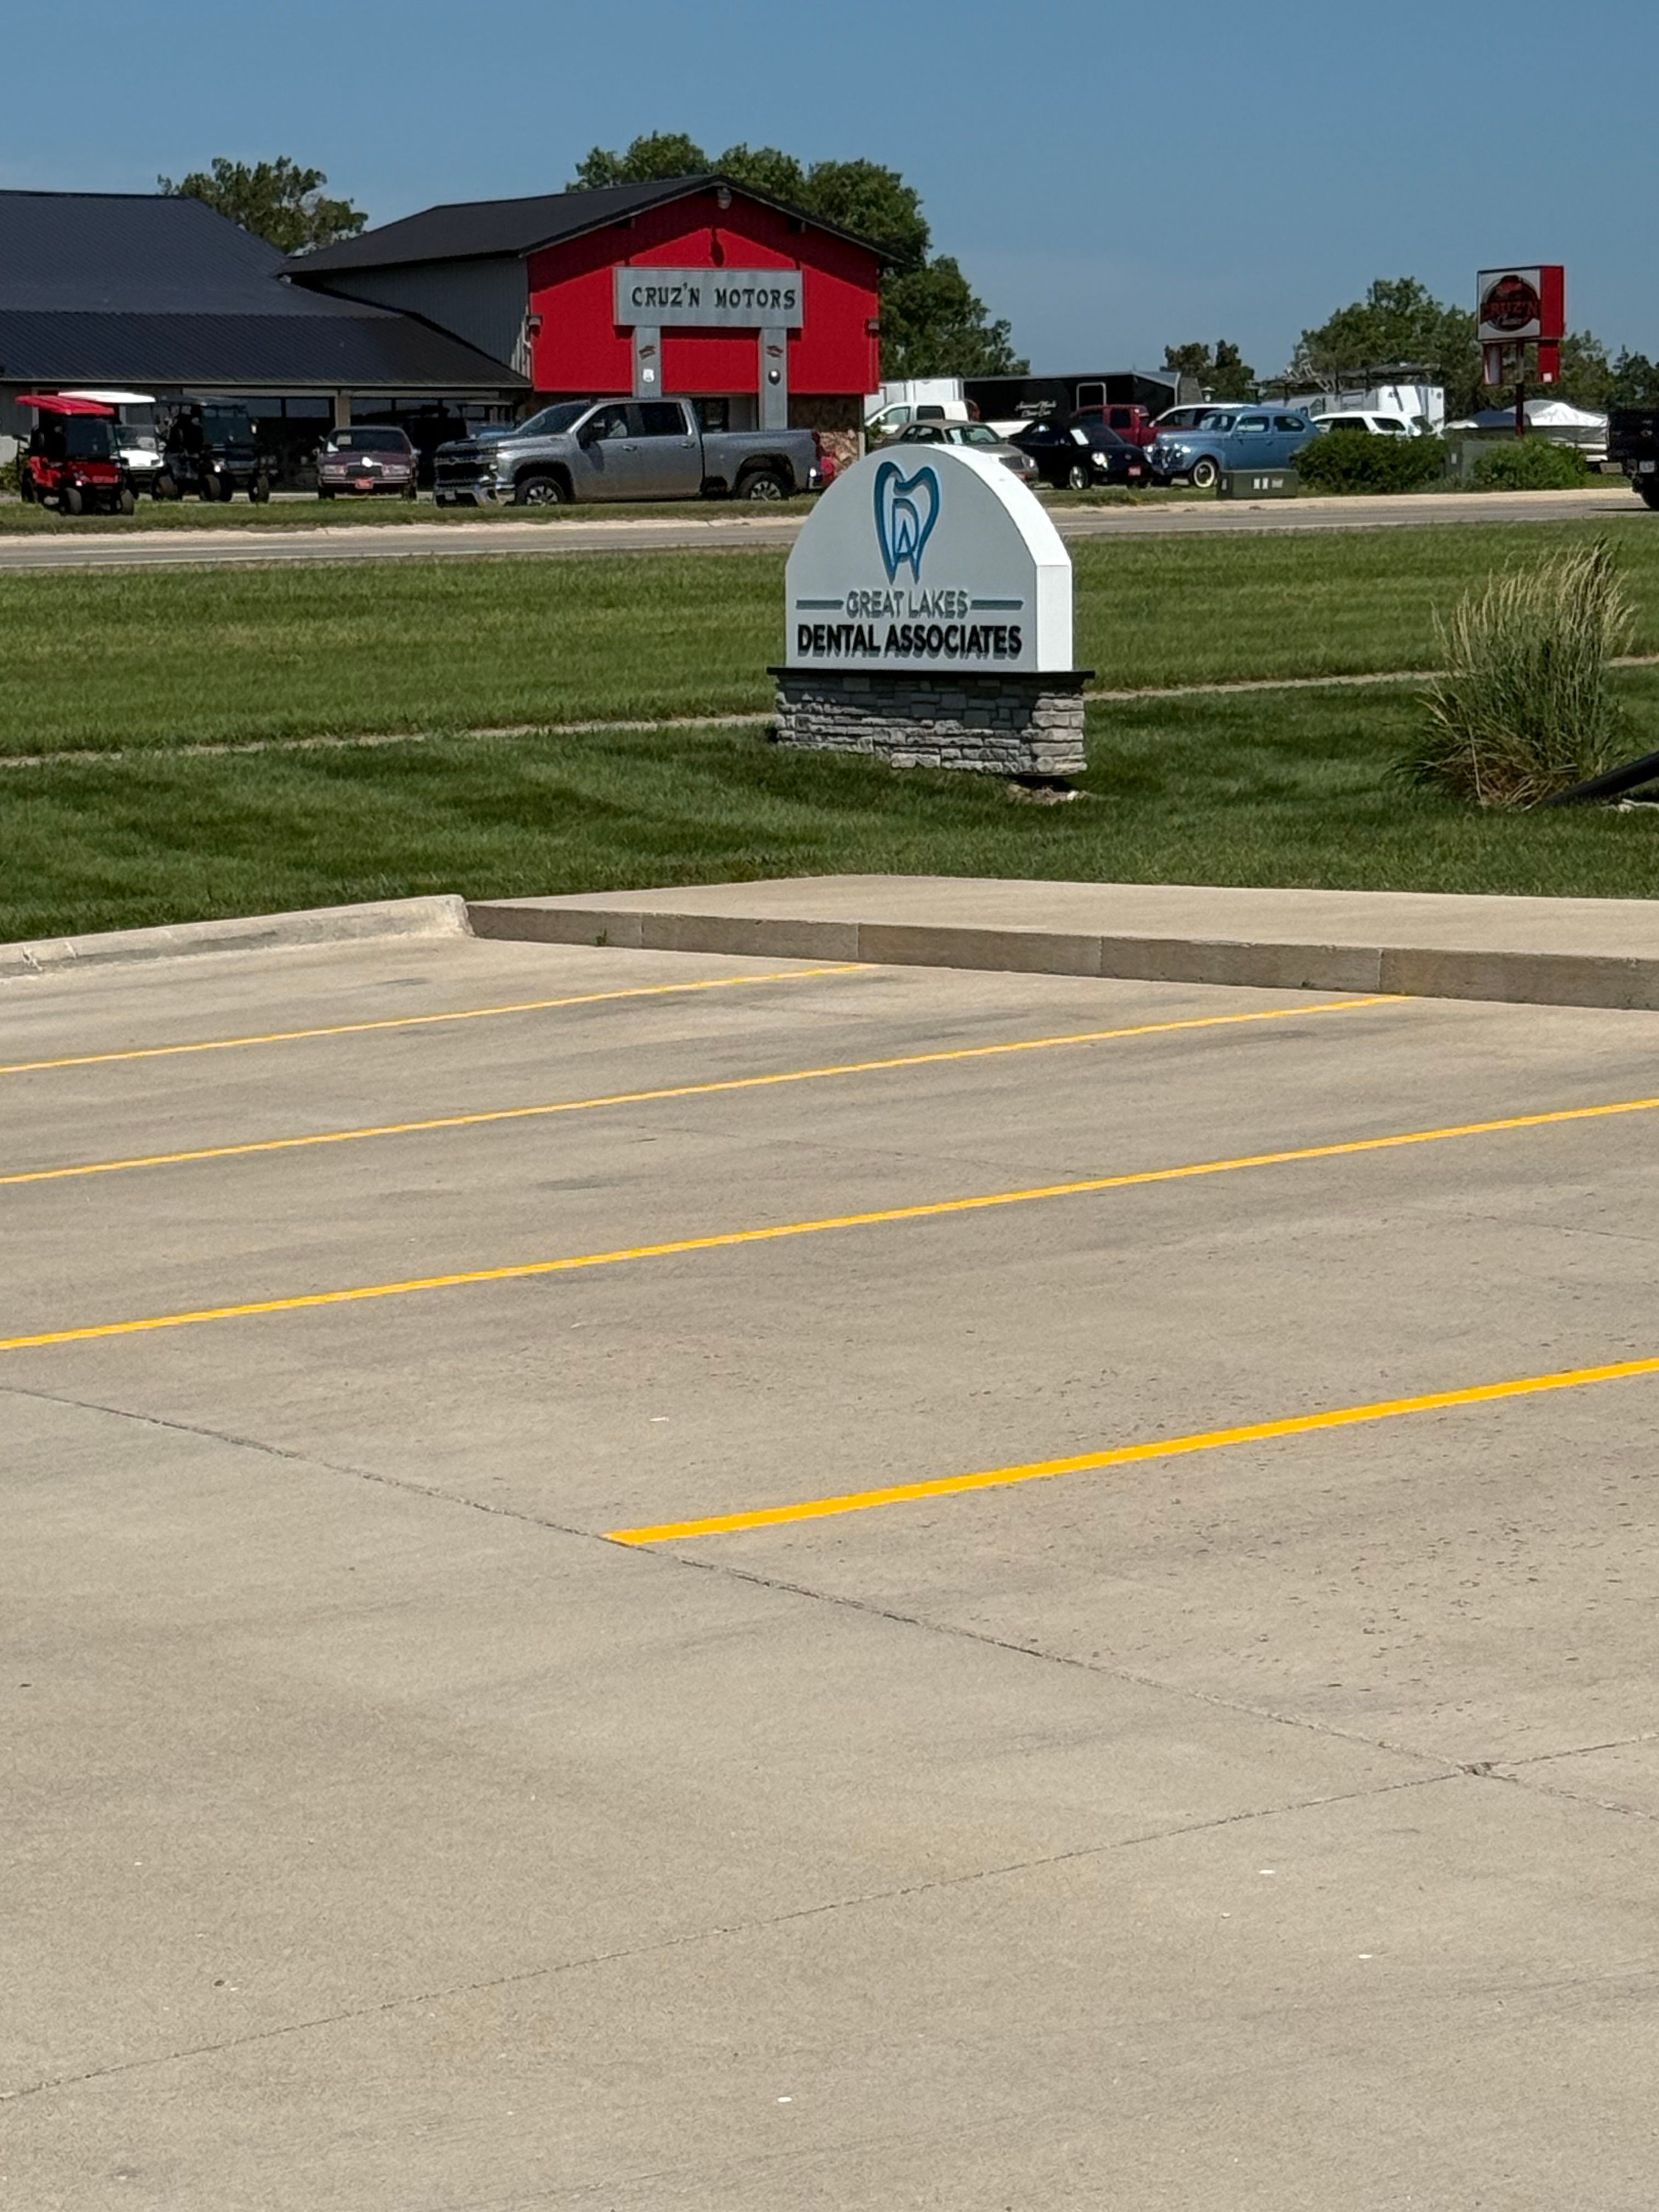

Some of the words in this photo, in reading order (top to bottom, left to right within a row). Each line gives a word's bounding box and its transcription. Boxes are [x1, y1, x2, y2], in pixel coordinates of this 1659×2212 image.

[631, 282, 700, 308] CRUZ'N
[714, 287, 795, 310] MOTORS
[847, 590, 904, 618] GREAT
[908, 590, 968, 619] LAKES
[798, 624, 881, 656] DENTAL
[884, 624, 1022, 657] ASSOCIATES
